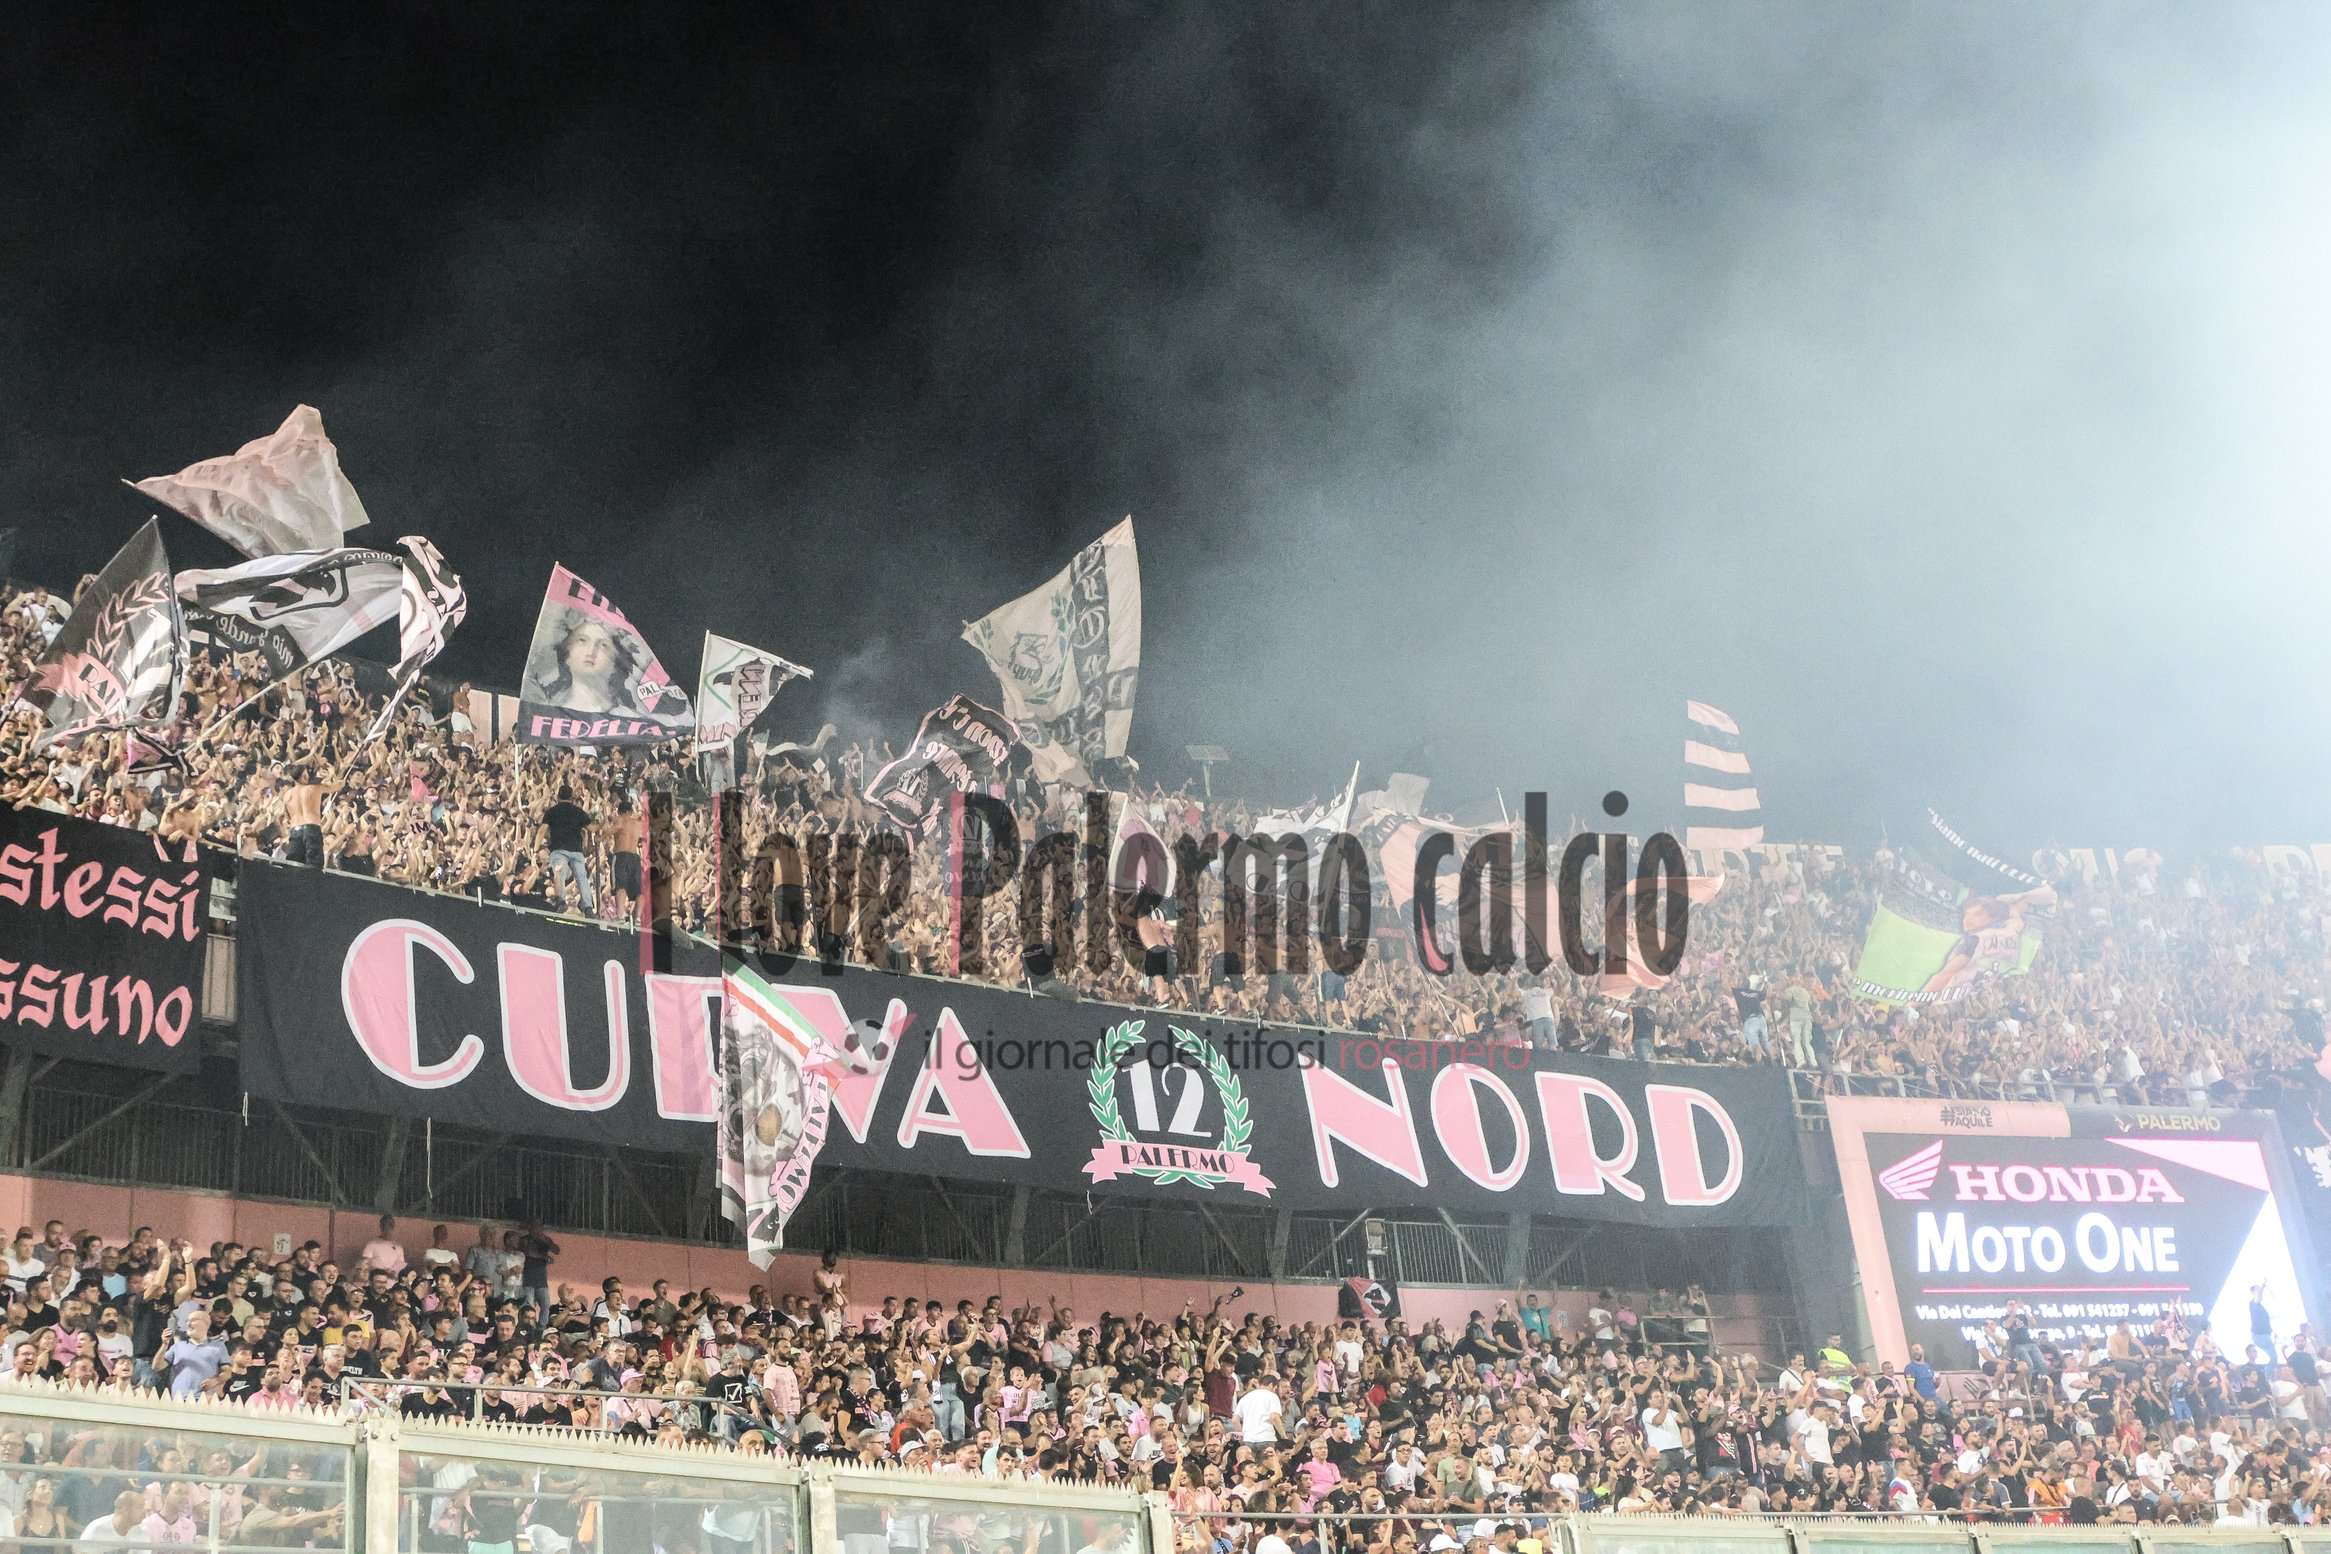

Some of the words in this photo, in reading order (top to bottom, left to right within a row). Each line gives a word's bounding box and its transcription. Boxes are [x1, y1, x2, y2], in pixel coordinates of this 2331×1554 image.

[1121, 1059, 1212, 1138] 12
[1298, 1052, 1744, 1206] NORD
[2137, 1114, 2221, 1132] PALERMO
[1119, 1144, 1235, 1175] PALERMO
[1948, 1164, 2185, 1203] HONDA
